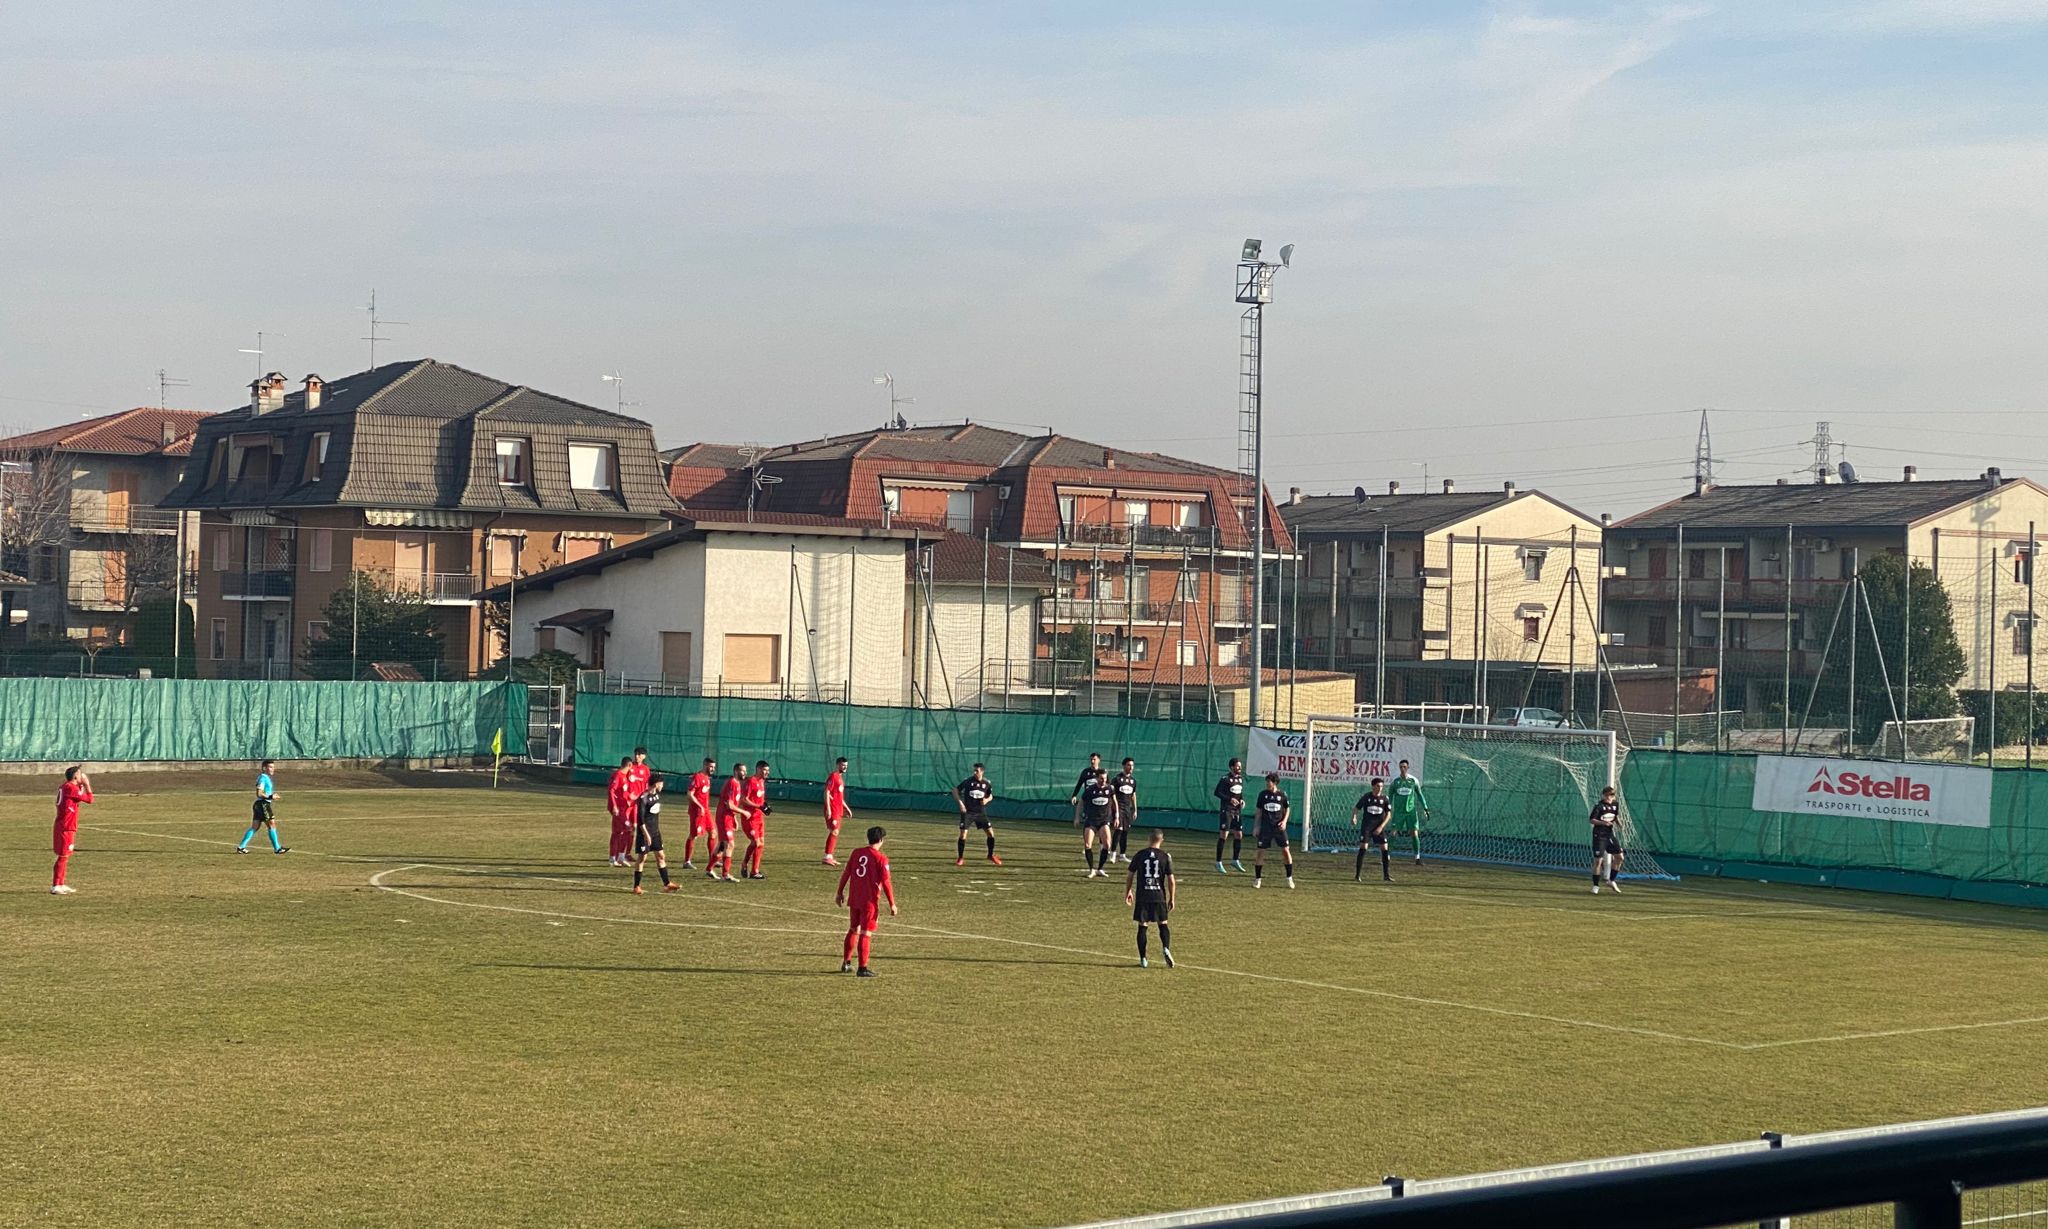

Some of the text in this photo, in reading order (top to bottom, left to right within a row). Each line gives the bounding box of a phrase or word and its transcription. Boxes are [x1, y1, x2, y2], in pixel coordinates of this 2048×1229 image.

[1344, 736, 1396, 752] SPORT
[1345, 759, 1391, 777] WORK
[1837, 772, 1930, 801] Stella
[1806, 800, 1861, 812] TRASPORTI
[1877, 806, 1930, 816] LOGISTICA
[856, 855, 868, 877] 3
[1144, 859, 1160, 878] 11
